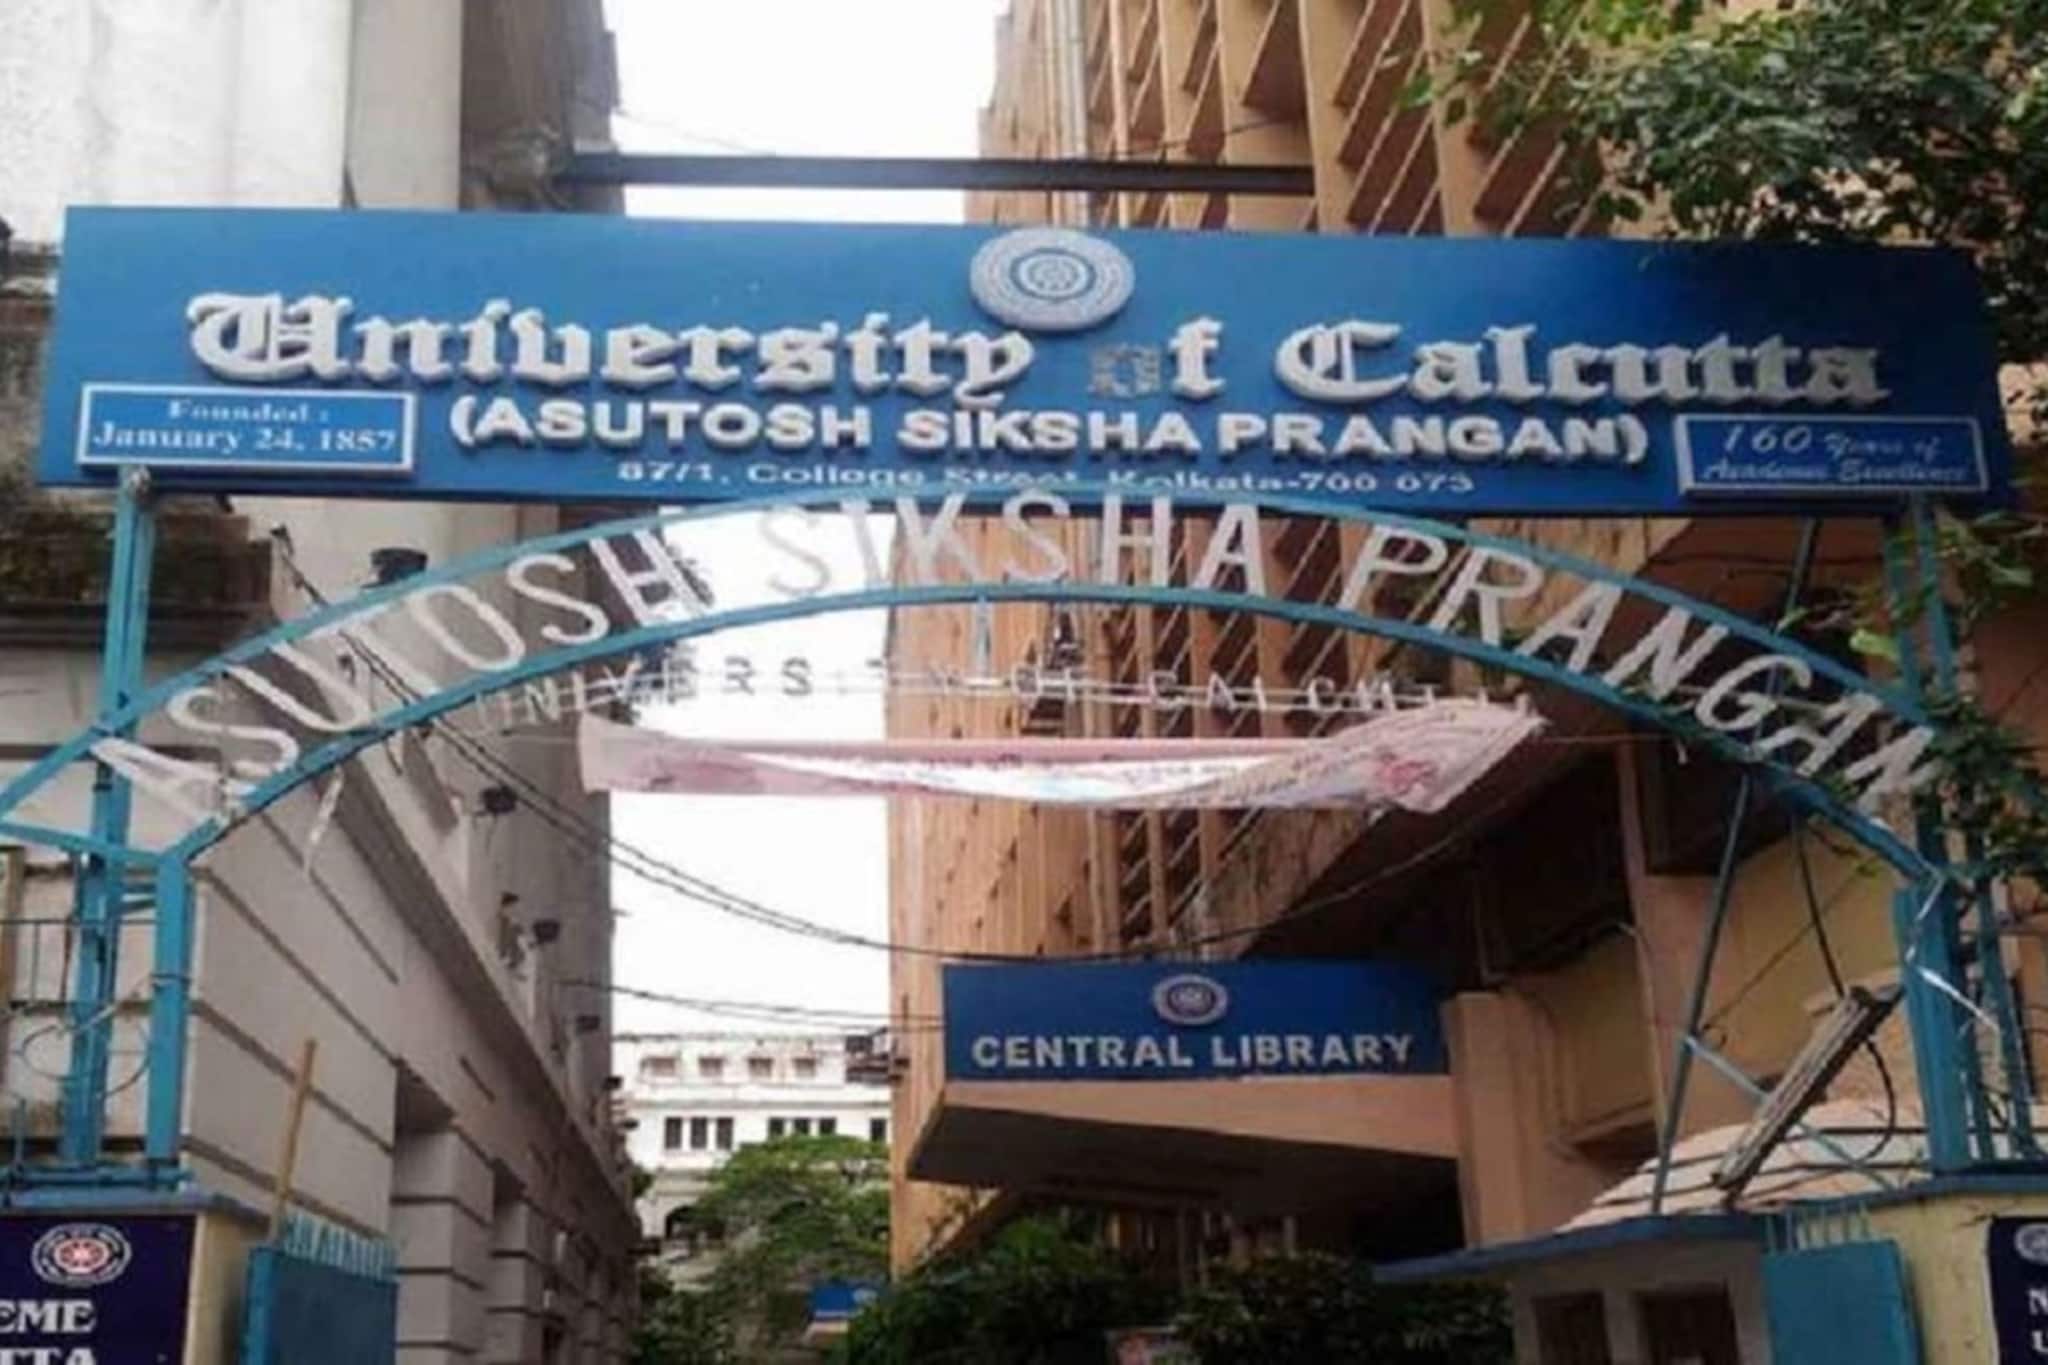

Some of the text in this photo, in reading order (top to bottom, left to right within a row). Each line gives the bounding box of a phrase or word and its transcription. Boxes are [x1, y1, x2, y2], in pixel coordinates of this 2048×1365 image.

[185, 293, 1035, 407] University
[1275, 320, 1890, 403] Calcutta
[167, 399, 308, 422] Founded
[93, 421, 396, 454] January 24, 1857
[449, 396, 1650, 465] (ASUTOSH SIKSHA PRANGAN)
[1724, 423, 1812, 454] 160
[617, 461, 729, 486] 87/1,
[1396, 471, 1474, 493] 073
[90, 489, 1945, 826] ASUTOSH SIKSHA PRANGAN
[971, 1033, 1414, 1069] CENTRAL LIBRARY
